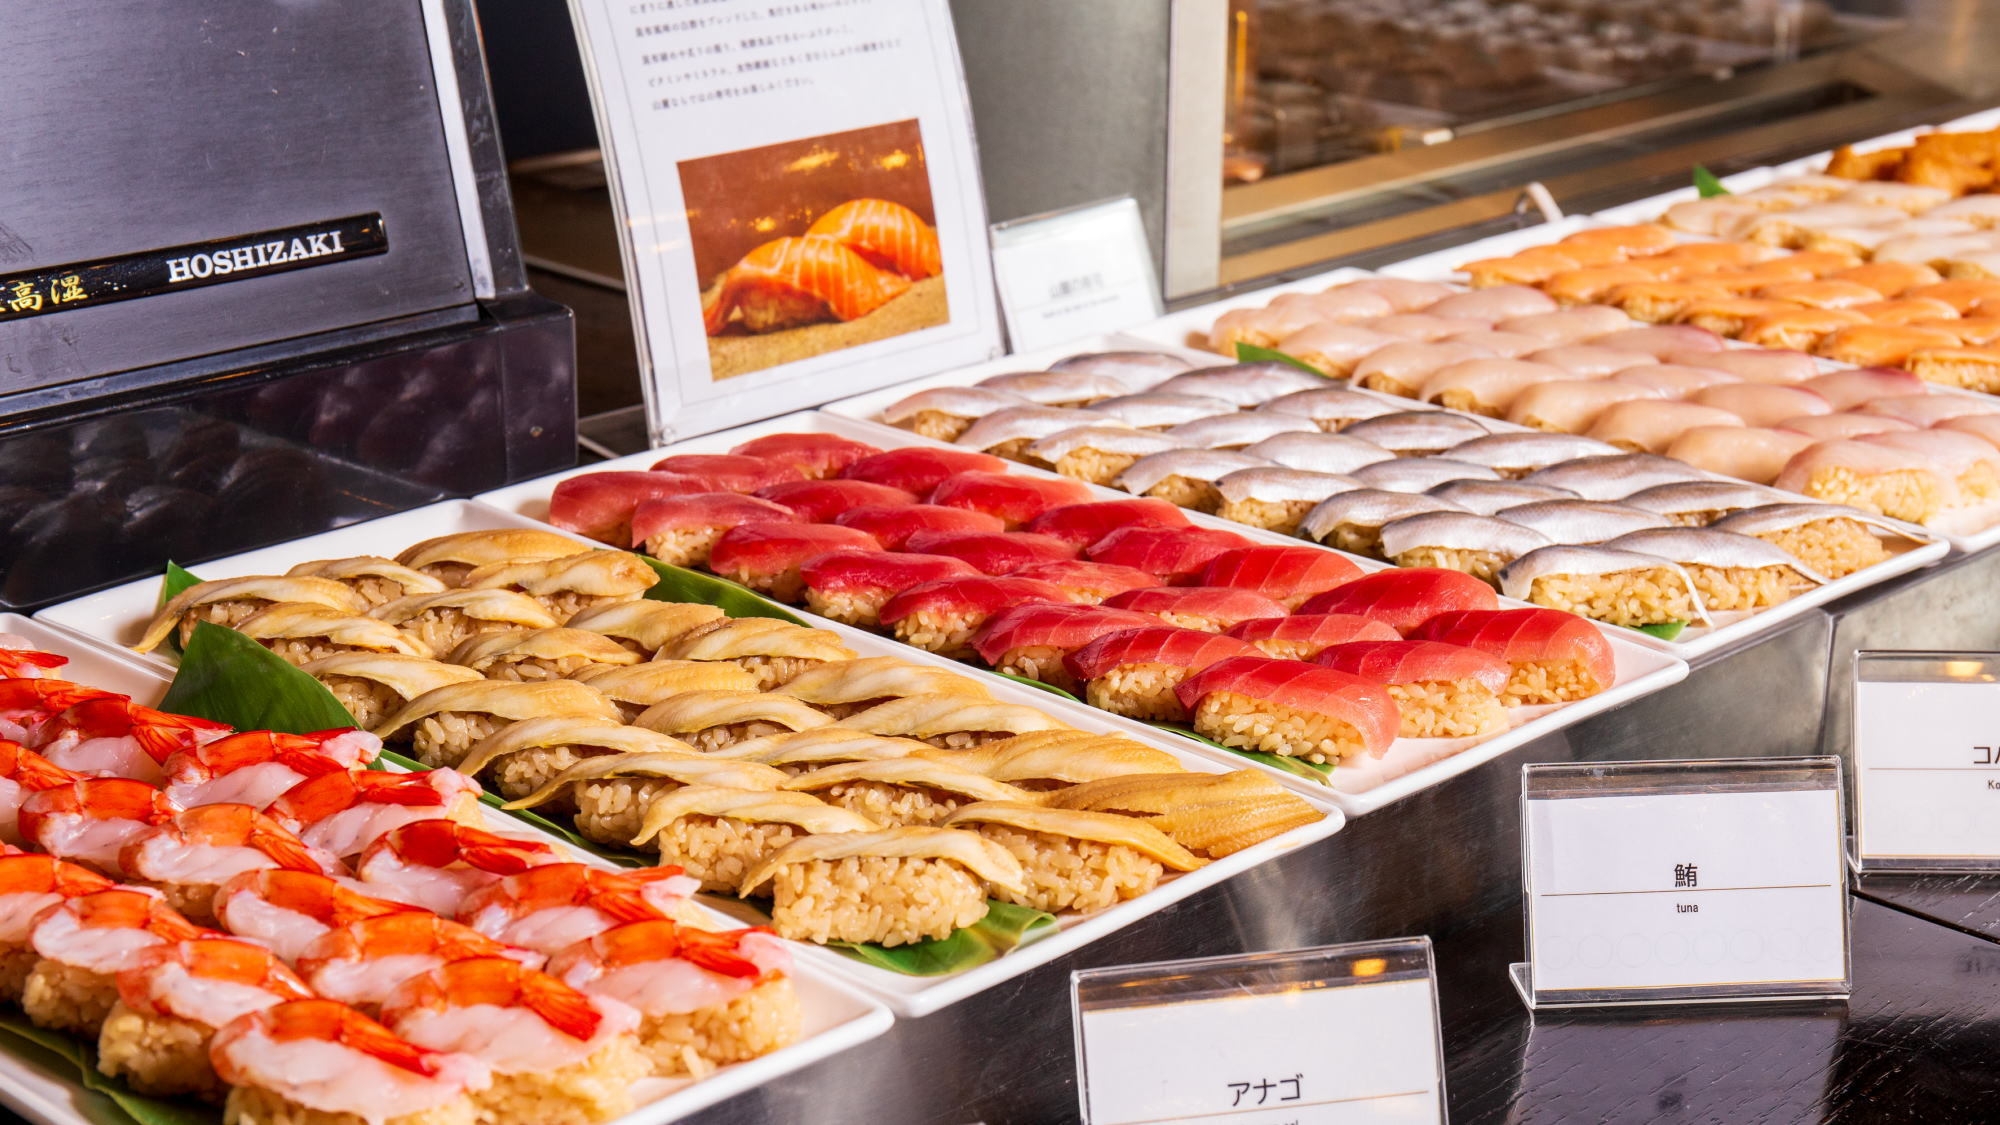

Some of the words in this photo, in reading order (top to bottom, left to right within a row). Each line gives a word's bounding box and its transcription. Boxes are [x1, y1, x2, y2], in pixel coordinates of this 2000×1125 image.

[166, 230, 345, 282] HOSHIZAKI
[0, 275, 89, 313] 高湿
[1674, 863, 1698, 888] 鮪
[1676, 902, 1699, 913] tuna
[1227, 1073, 1304, 1107] アナゴ
